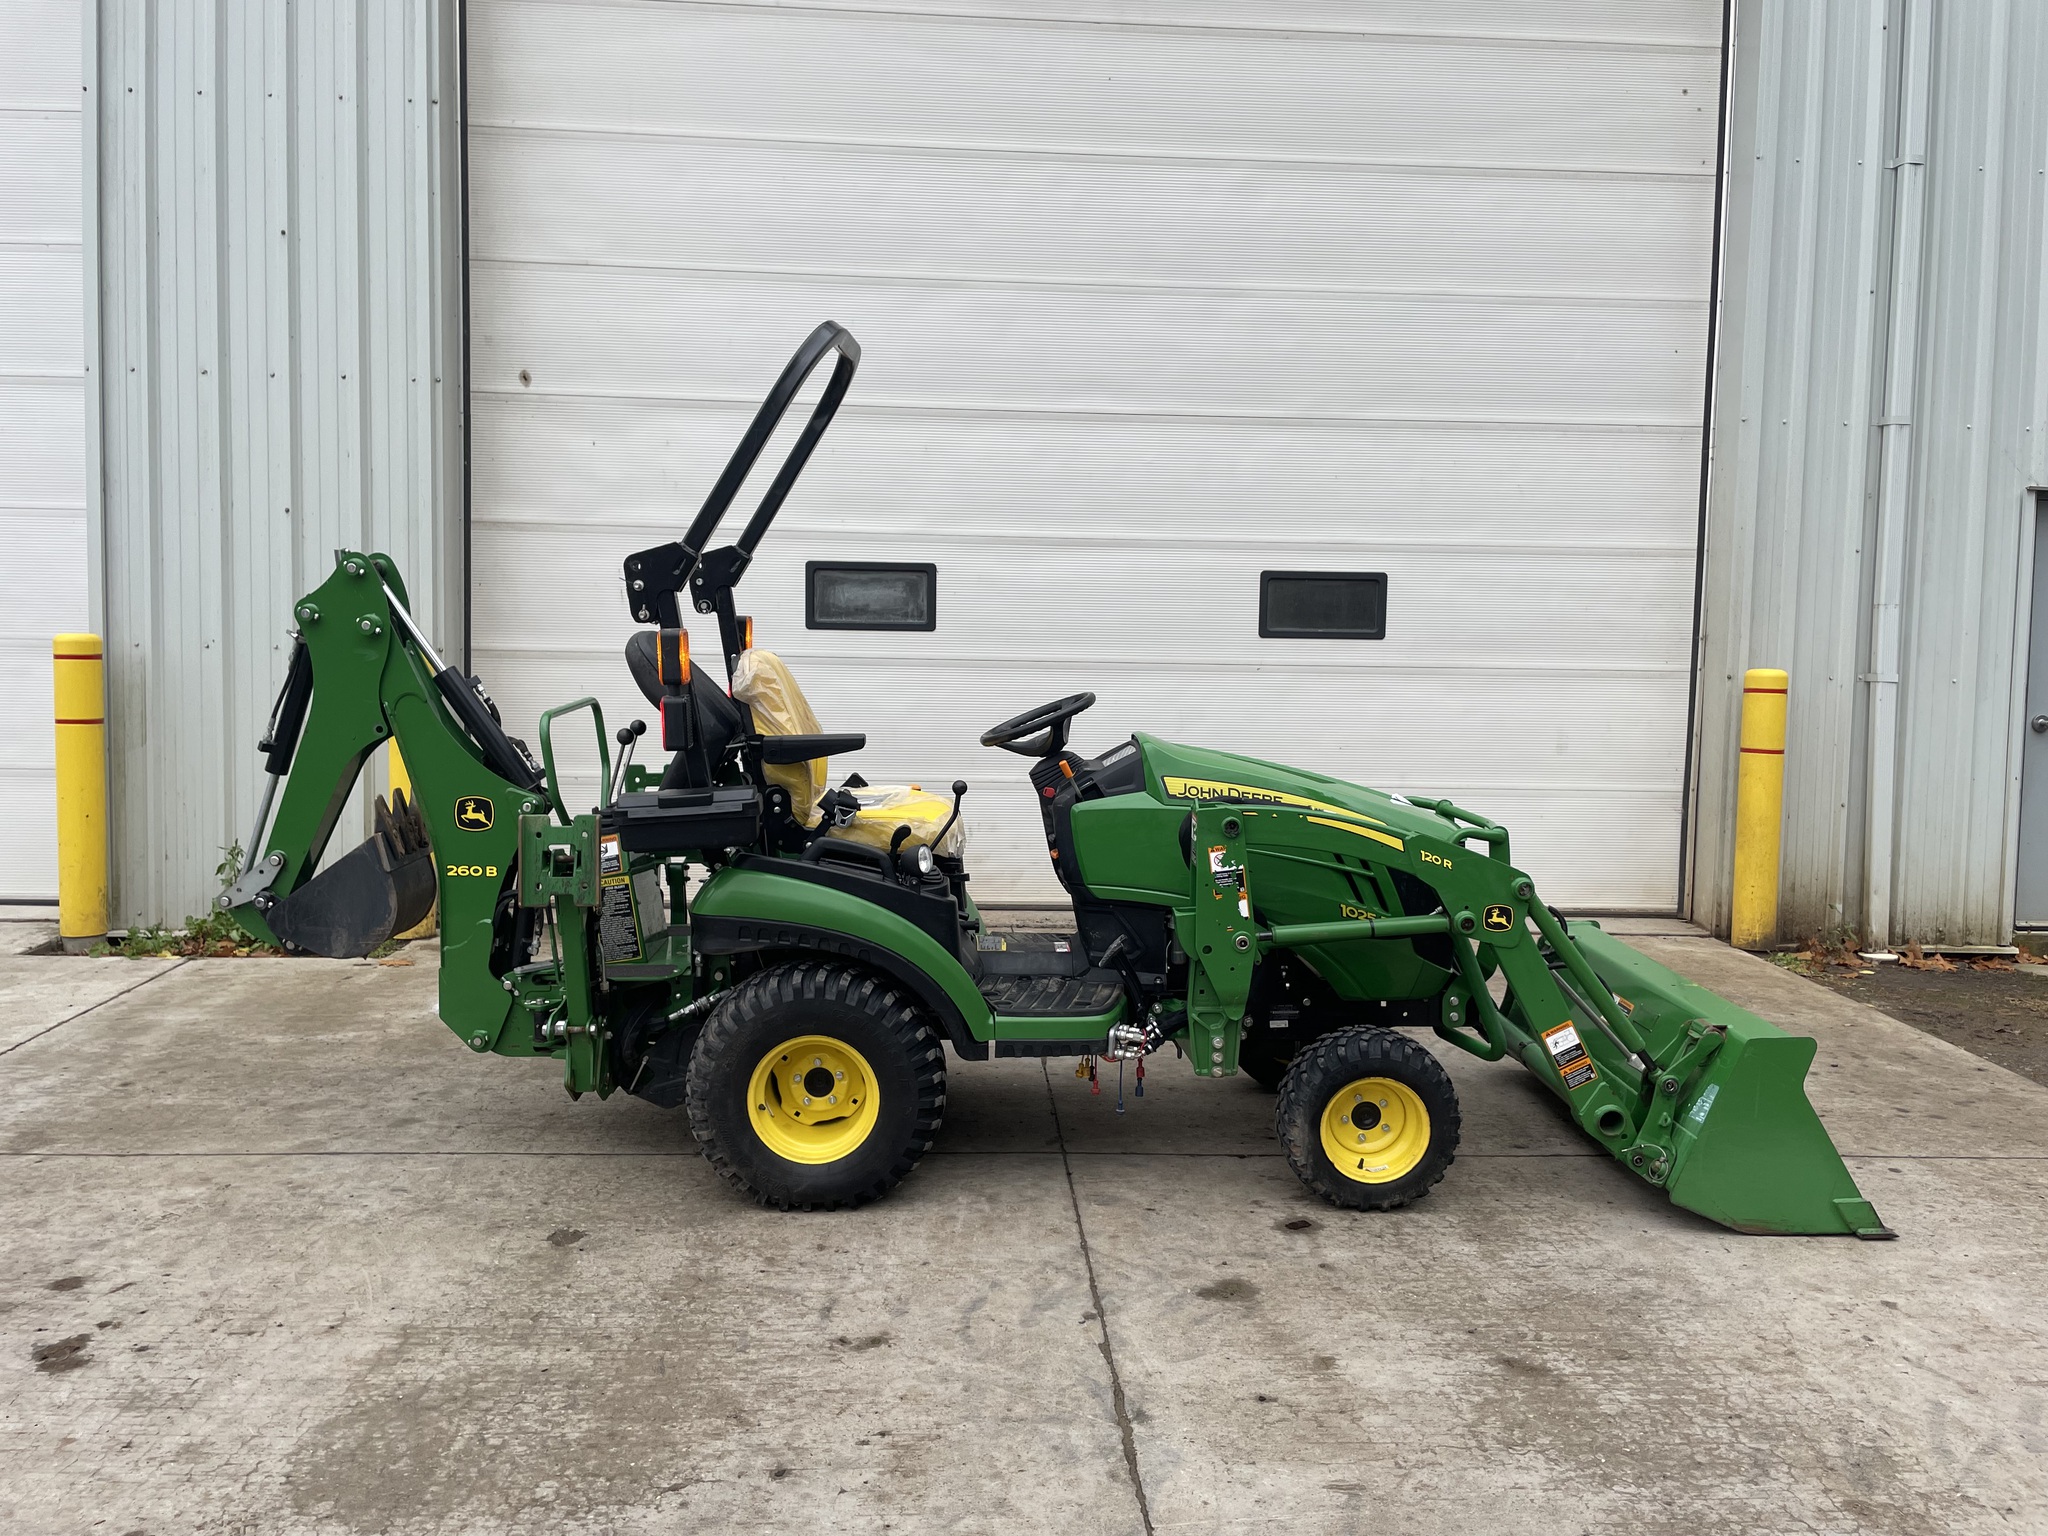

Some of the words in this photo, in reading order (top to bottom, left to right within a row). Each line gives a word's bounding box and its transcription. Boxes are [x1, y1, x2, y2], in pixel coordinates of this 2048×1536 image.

[1178, 783, 1223, 798] JOHN
[1420, 849, 1442, 865] 120
[1443, 858, 1452, 870] R
[446, 864, 483, 877] 260
[486, 865, 498, 877] B
